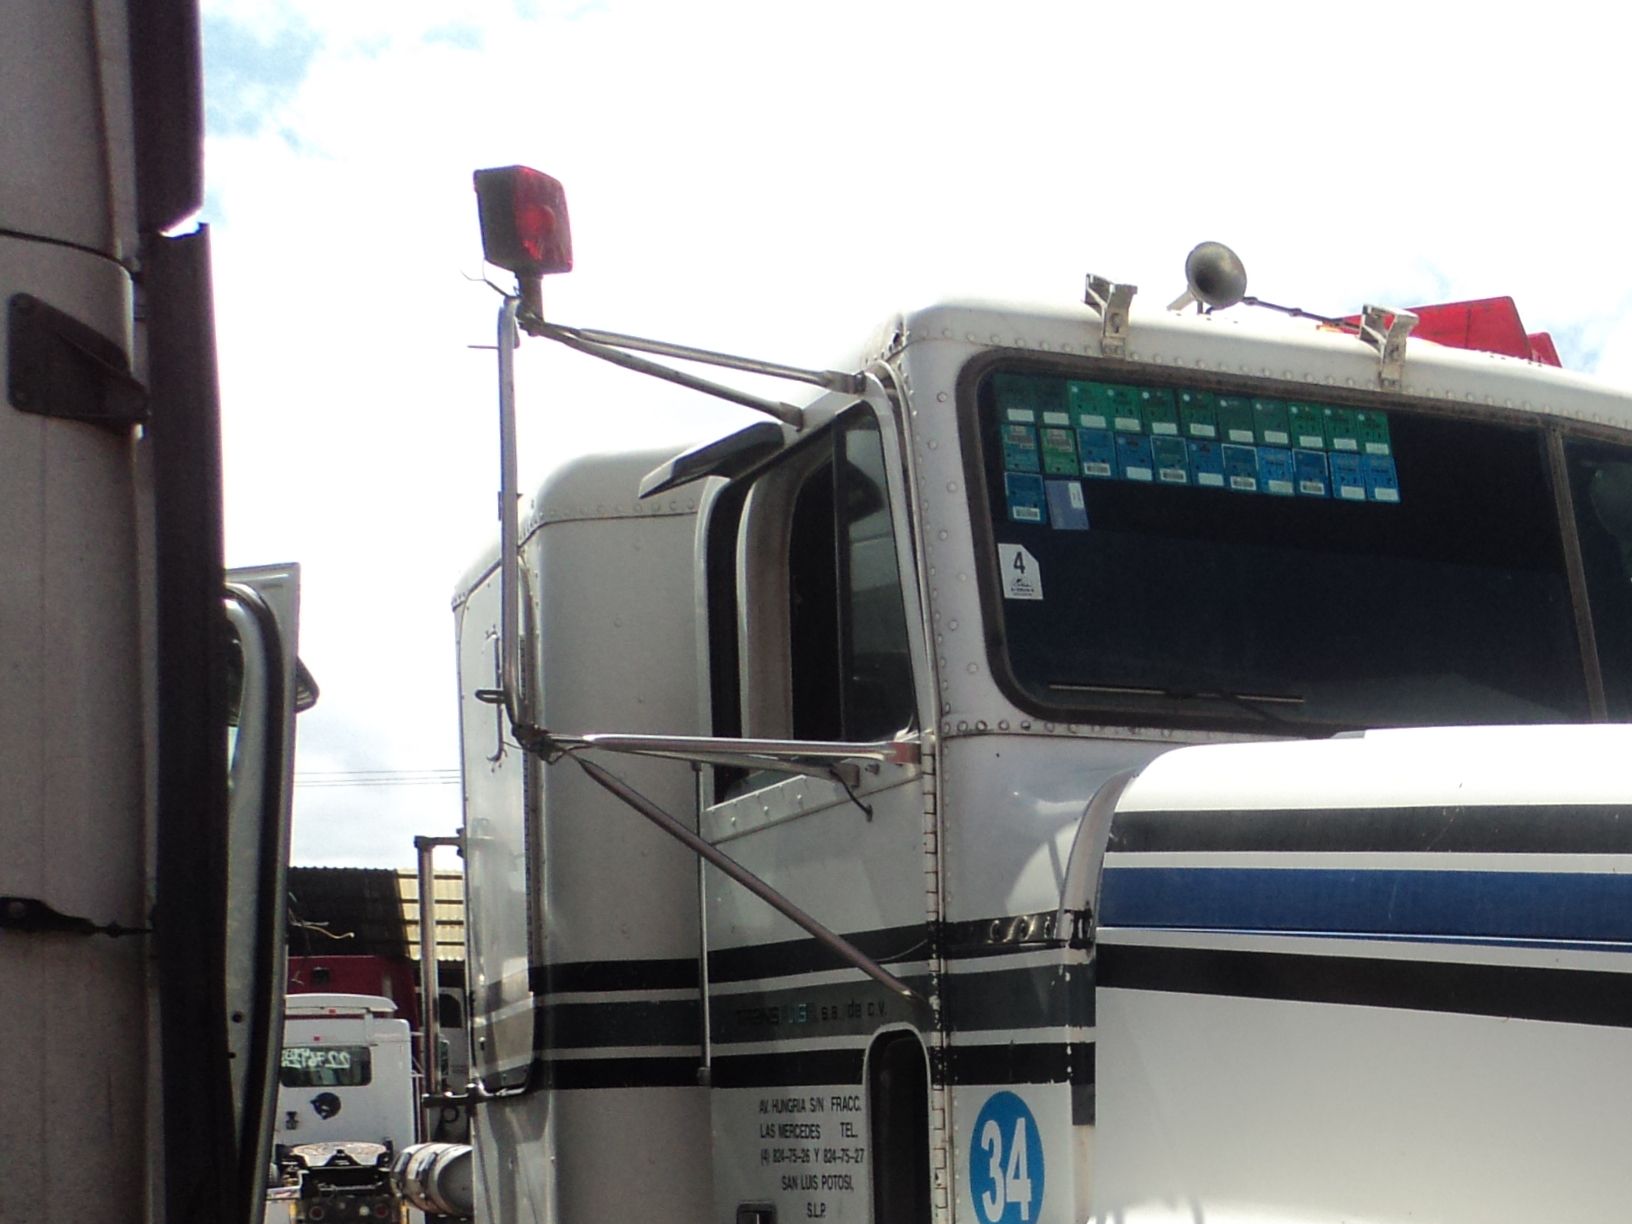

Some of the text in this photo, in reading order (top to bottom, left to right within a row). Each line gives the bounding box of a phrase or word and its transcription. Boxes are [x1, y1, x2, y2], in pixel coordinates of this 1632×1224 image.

[1013, 551, 1026, 575] 4
[771, 1097, 807, 1114] HUNGRIA
[830, 1095, 862, 1113] FRACC.
[760, 1122, 859, 1140] LAS MERCEDES TEL.
[814, 1148, 820, 1164] Y
[980, 1116, 1033, 1224] 34
[781, 1174, 799, 1191] SAN
[801, 1174, 819, 1191] LUIS
